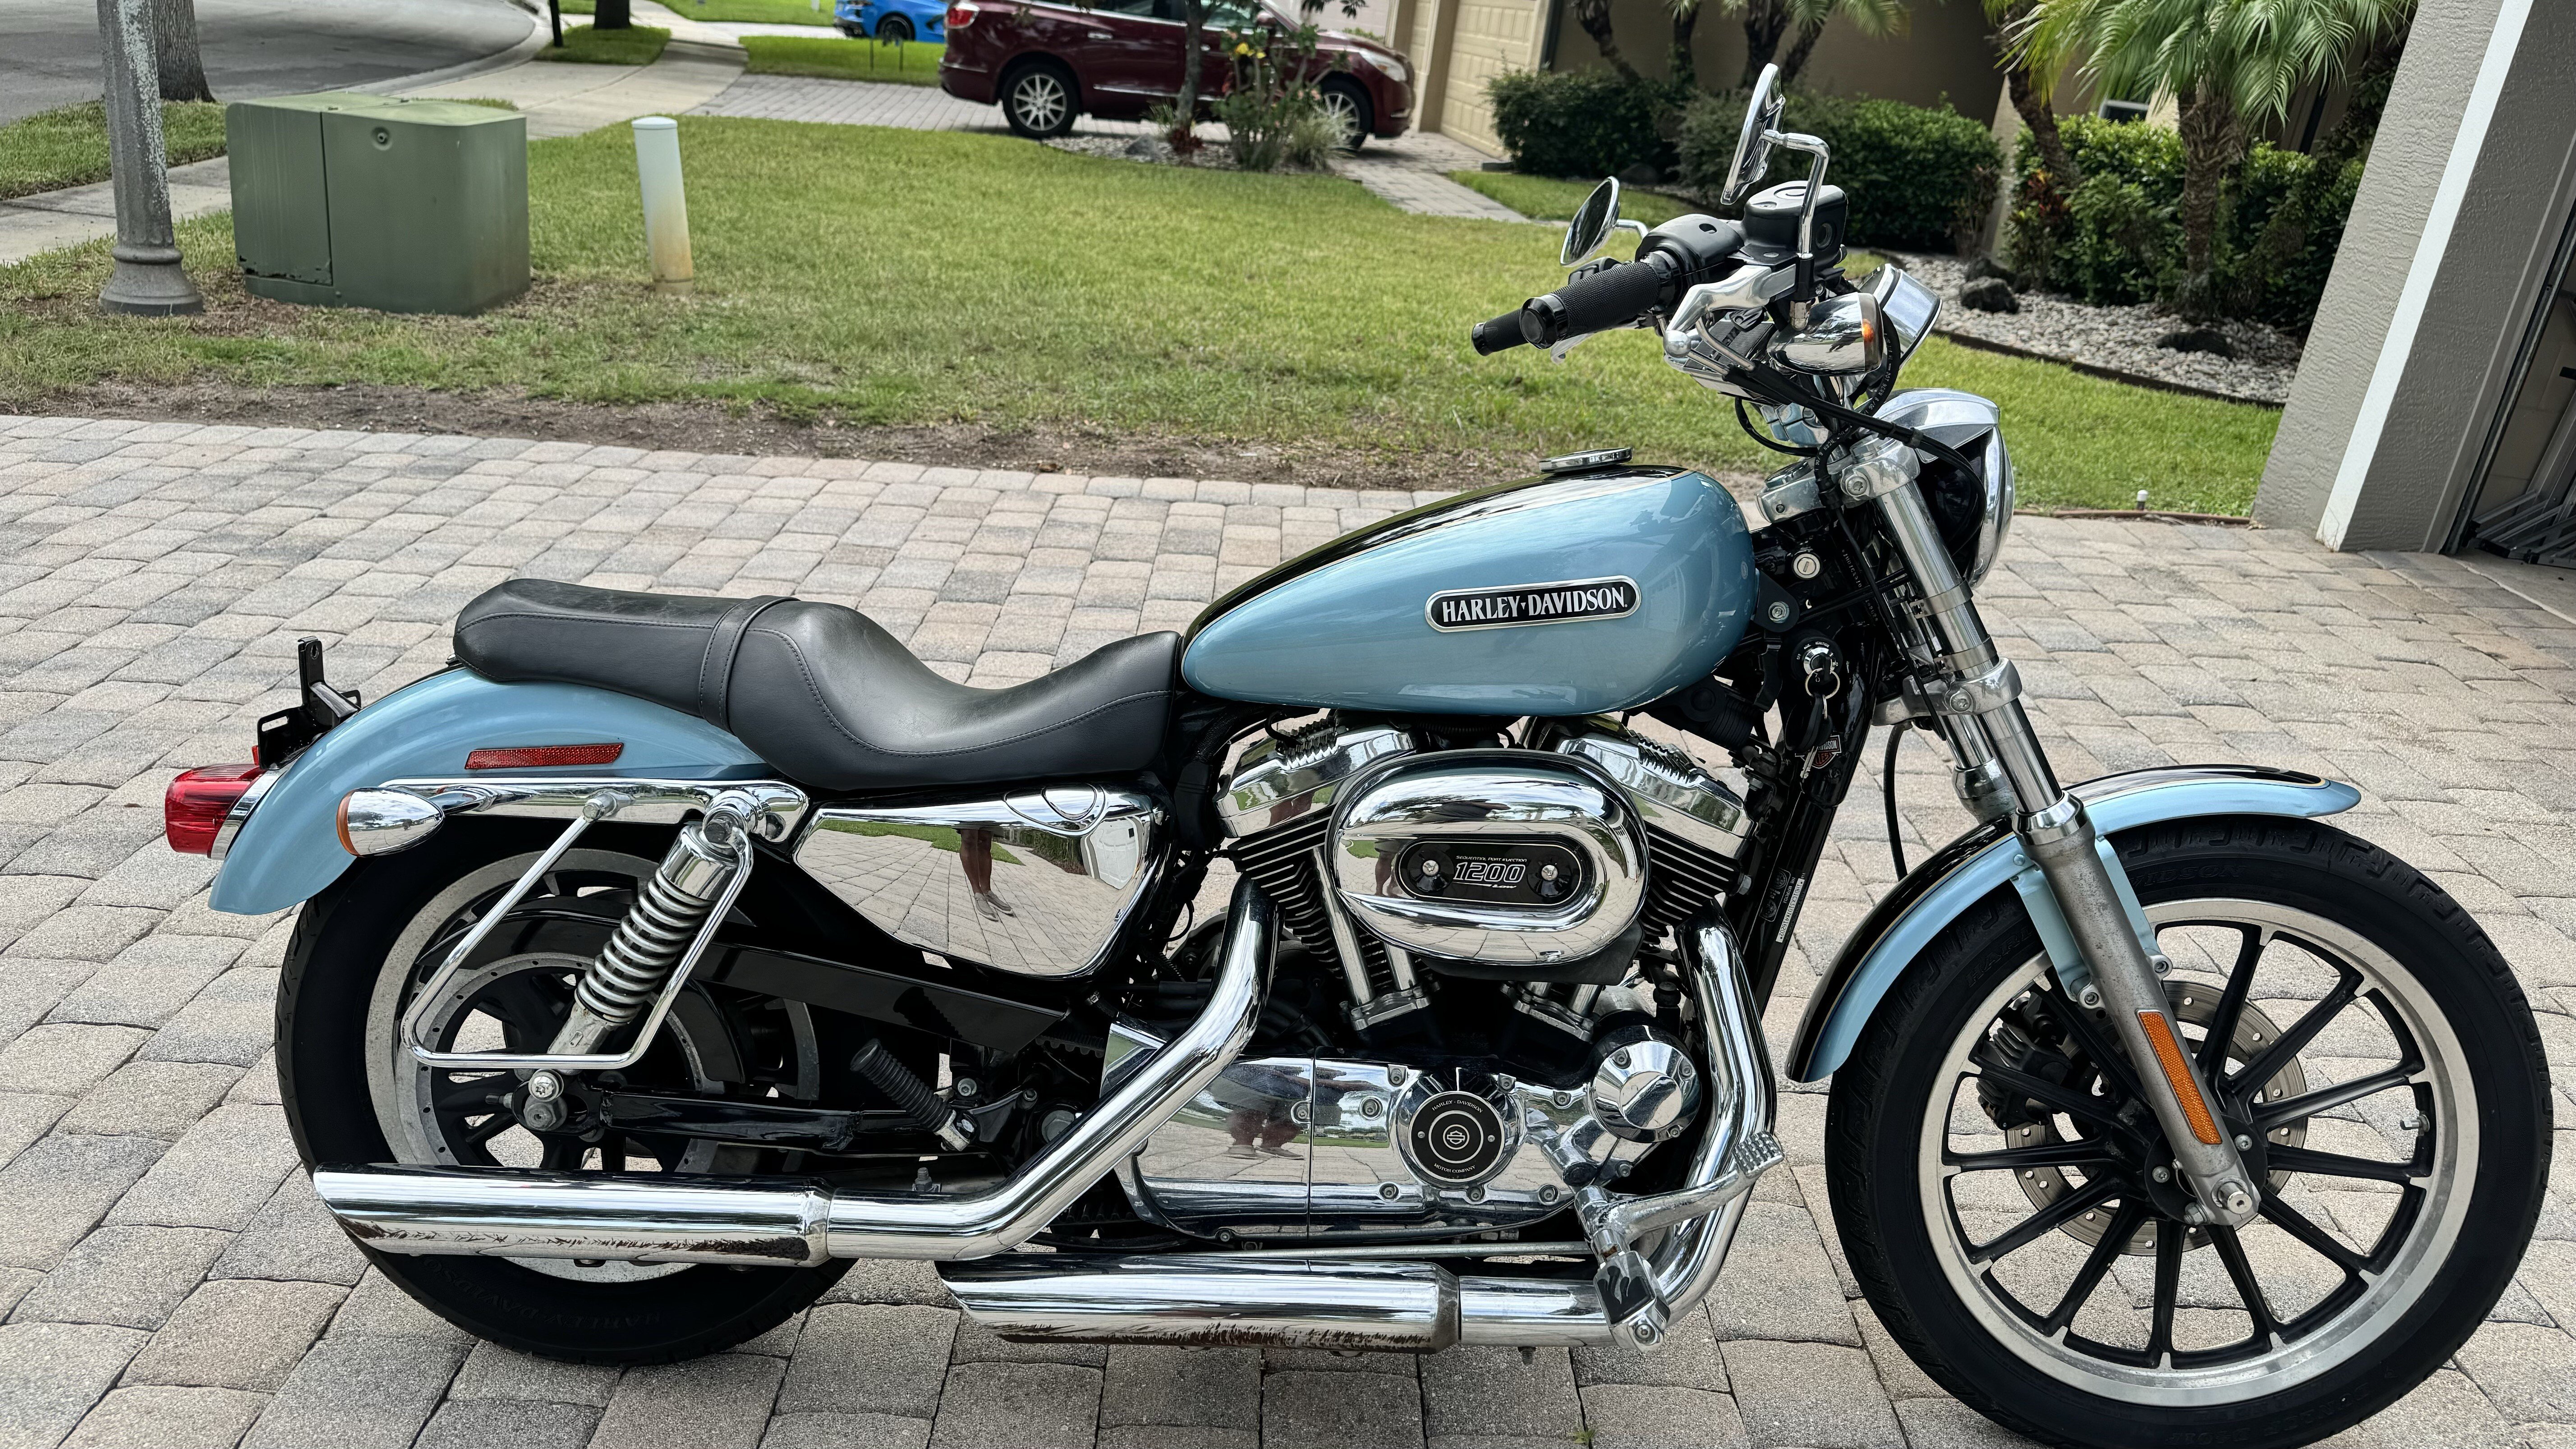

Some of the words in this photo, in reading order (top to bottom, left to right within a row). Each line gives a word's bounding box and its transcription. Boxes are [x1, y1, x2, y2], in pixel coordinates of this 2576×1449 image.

[1453, 862, 1526, 883] 1200
[1432, 1099, 1453, 1111] HARLEY
[1457, 1099, 1483, 1113] DAVIDSON
[1434, 1163, 1451, 1173] MOTOR
[1452, 1164, 1475, 1173] COMPANY
